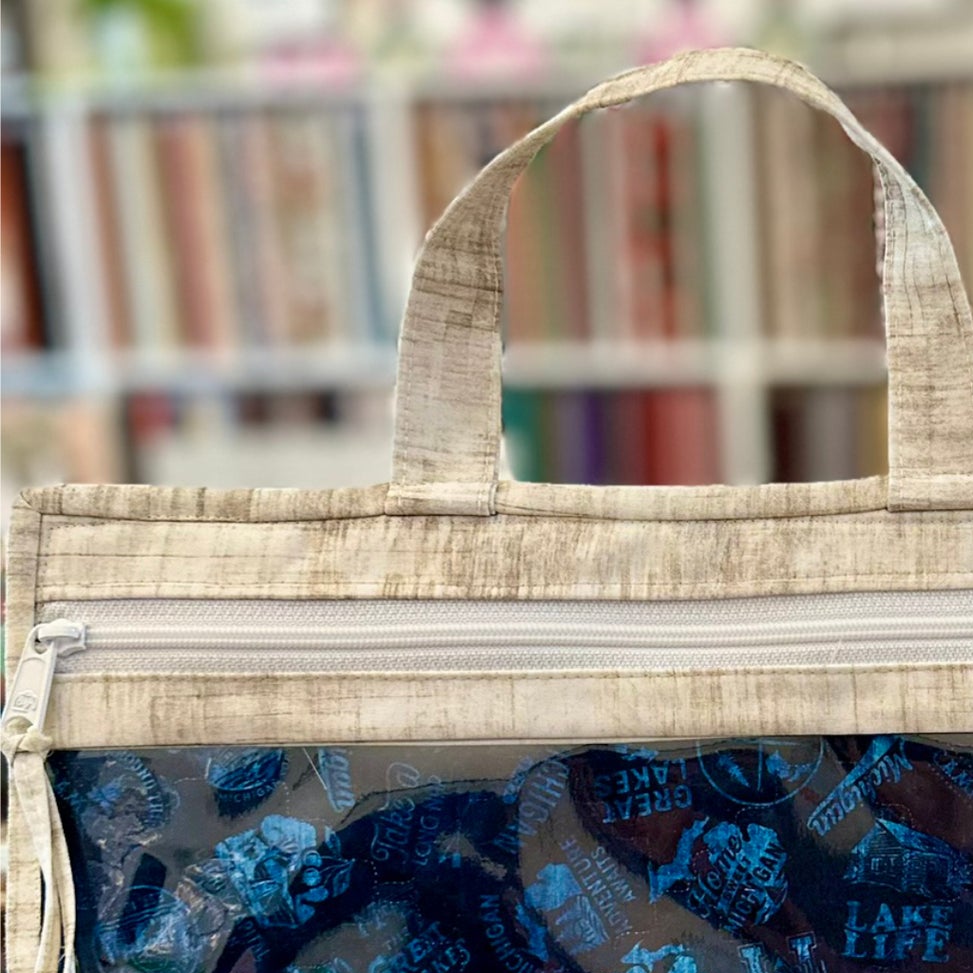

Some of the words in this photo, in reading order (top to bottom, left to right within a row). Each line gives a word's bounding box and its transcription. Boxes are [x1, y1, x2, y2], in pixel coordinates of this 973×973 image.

[595, 757, 688, 797] LAKES
[602, 784, 693, 824] GREAT
[590, 845, 637, 904] AWAITS
[844, 900, 953, 934] LAKE
[842, 928, 950, 963] LIFE
